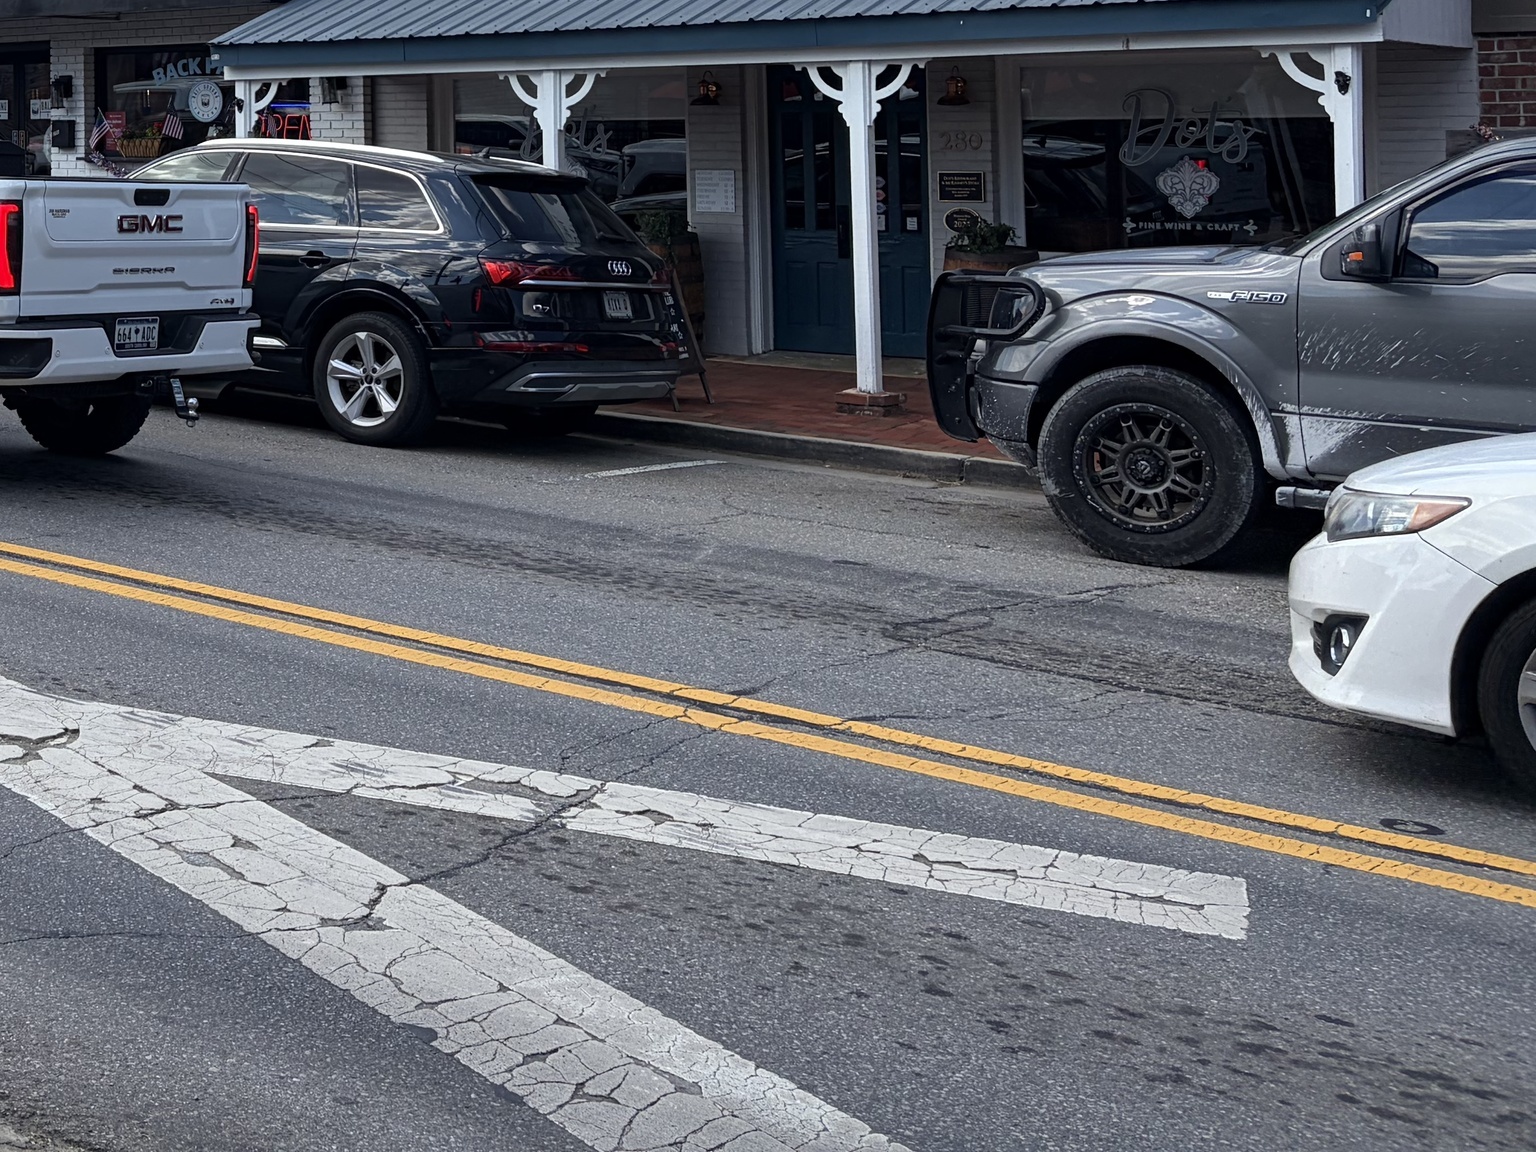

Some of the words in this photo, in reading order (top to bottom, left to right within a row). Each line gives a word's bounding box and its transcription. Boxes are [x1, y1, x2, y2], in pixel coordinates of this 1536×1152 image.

[152, 56, 202, 87] BACK
[939, 131, 983, 151] 280
[117, 214, 184, 233] GMC
[1164, 222, 1192, 230] WINE
[1207, 223, 1240, 231] CRAFT
[112, 266, 175, 275] SIERRA
[117, 327, 132, 342] 664
